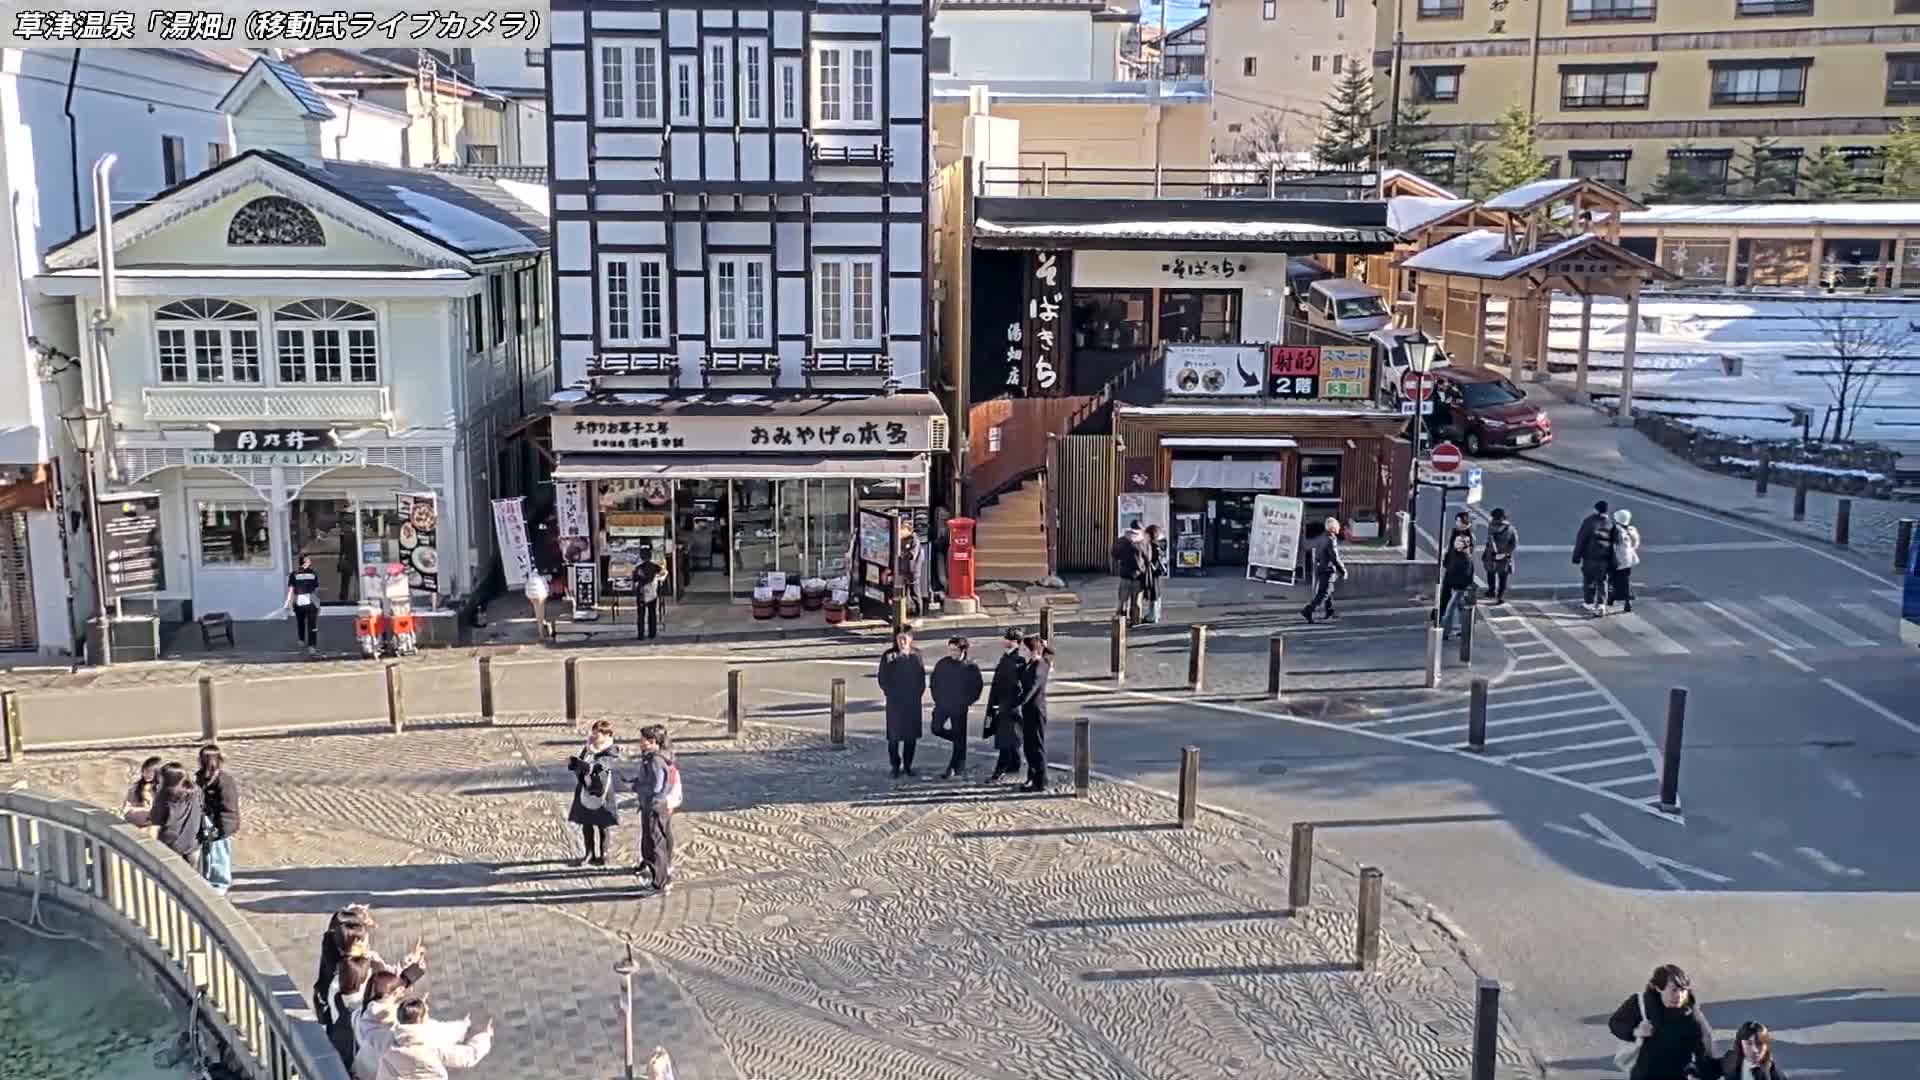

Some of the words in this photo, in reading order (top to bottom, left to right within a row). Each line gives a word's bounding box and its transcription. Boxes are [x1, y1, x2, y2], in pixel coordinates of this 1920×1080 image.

[1029, 252, 1063, 389] そばきら
[1274, 349, 1316, 372] 射的
[1275, 376, 1313, 394] 2階
[573, 420, 669, 435] 手作りお菓子工房
[750, 421, 908, 446] おみやげの本多
